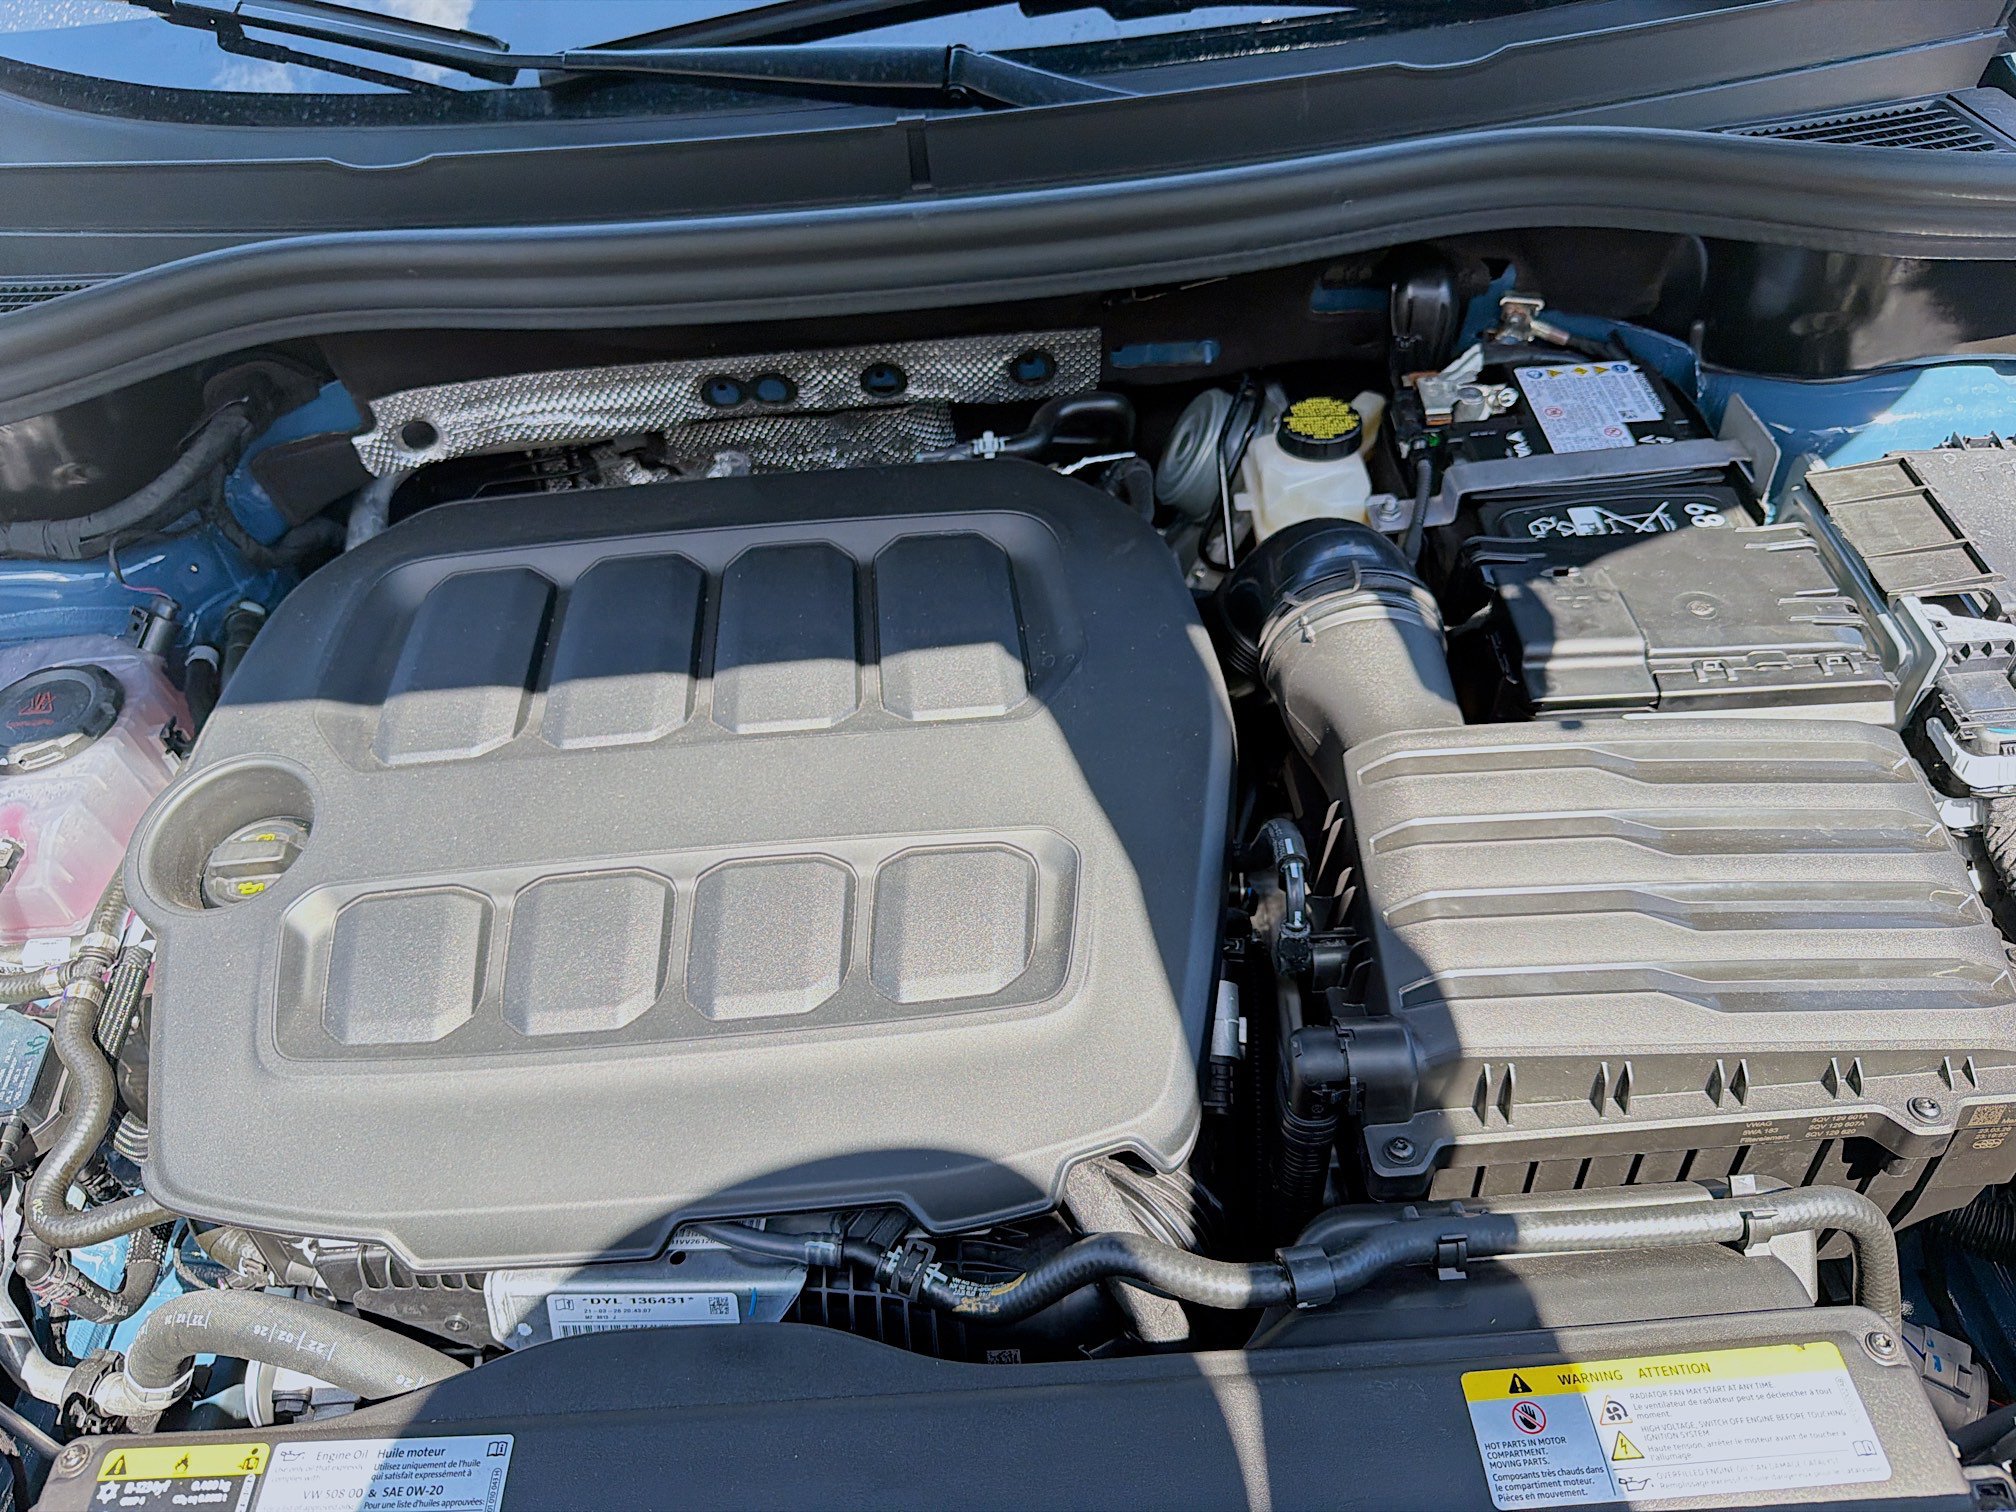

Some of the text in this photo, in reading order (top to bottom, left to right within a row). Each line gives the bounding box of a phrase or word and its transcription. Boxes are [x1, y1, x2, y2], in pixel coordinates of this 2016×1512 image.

[1557, 1362, 1711, 1386] WARNING ATTENTION
[1629, 1391, 1668, 1400] RADIATOR
[1669, 1389, 1685, 1397] FAN
[1704, 1385, 1726, 1394] START
[1645, 1400, 1685, 1410] ventilateur
[1688, 1398, 1698, 1406] de
[1700, 1395, 1734, 1405] radiateur
[1737, 1394, 1754, 1404] peut
[1766, 1389, 1808, 1399] déclencher
[1816, 1387, 1832, 1395] tout
[1641, 1425, 1660, 1433] HIGH
[1699, 1418, 1730, 1428] SWITCH
[1731, 1417, 1745, 1425] OFF
[1746, 1415, 1775, 1424] ENGINE
[1776, 1412, 1805, 1421] BEFORE
[1807, 1409, 1847, 1419] TOUCHING
[1484, 1436, 1567, 1450] HOT PARTS IN MOTOR
[1643, 1432, 1680, 1442] IGNITION
[1648, 1444, 1672, 1453] Haute
[1744, 1436, 1772, 1445] moteur
[1775, 1434, 1796, 1442] avant
[1798, 1432, 1808, 1440] de
[316, 1449, 368, 1463] Engine Oil
[377, 1448, 446, 1459] Huile moteur
[1487, 1448, 1548, 1460] COMPARTMENT.
[374, 1459, 481, 1472] Utilisez uniquement de l'huile
[1489, 1457, 1550, 1470] MOVING PARTS.
[371, 1468, 472, 1482] qui satisfait expressément à
[1492, 1465, 1605, 1482] Composants très chauds dans
[303, 1485, 444, 1499] VW 508 00 & SAE 0W-20
[1495, 1478, 1595, 1492] le compartiment moteur.
[1498, 1489, 1588, 1503] Pièces en mouvement.
[364, 1498, 485, 1510] Pour une liste d'huiles approuvées:
